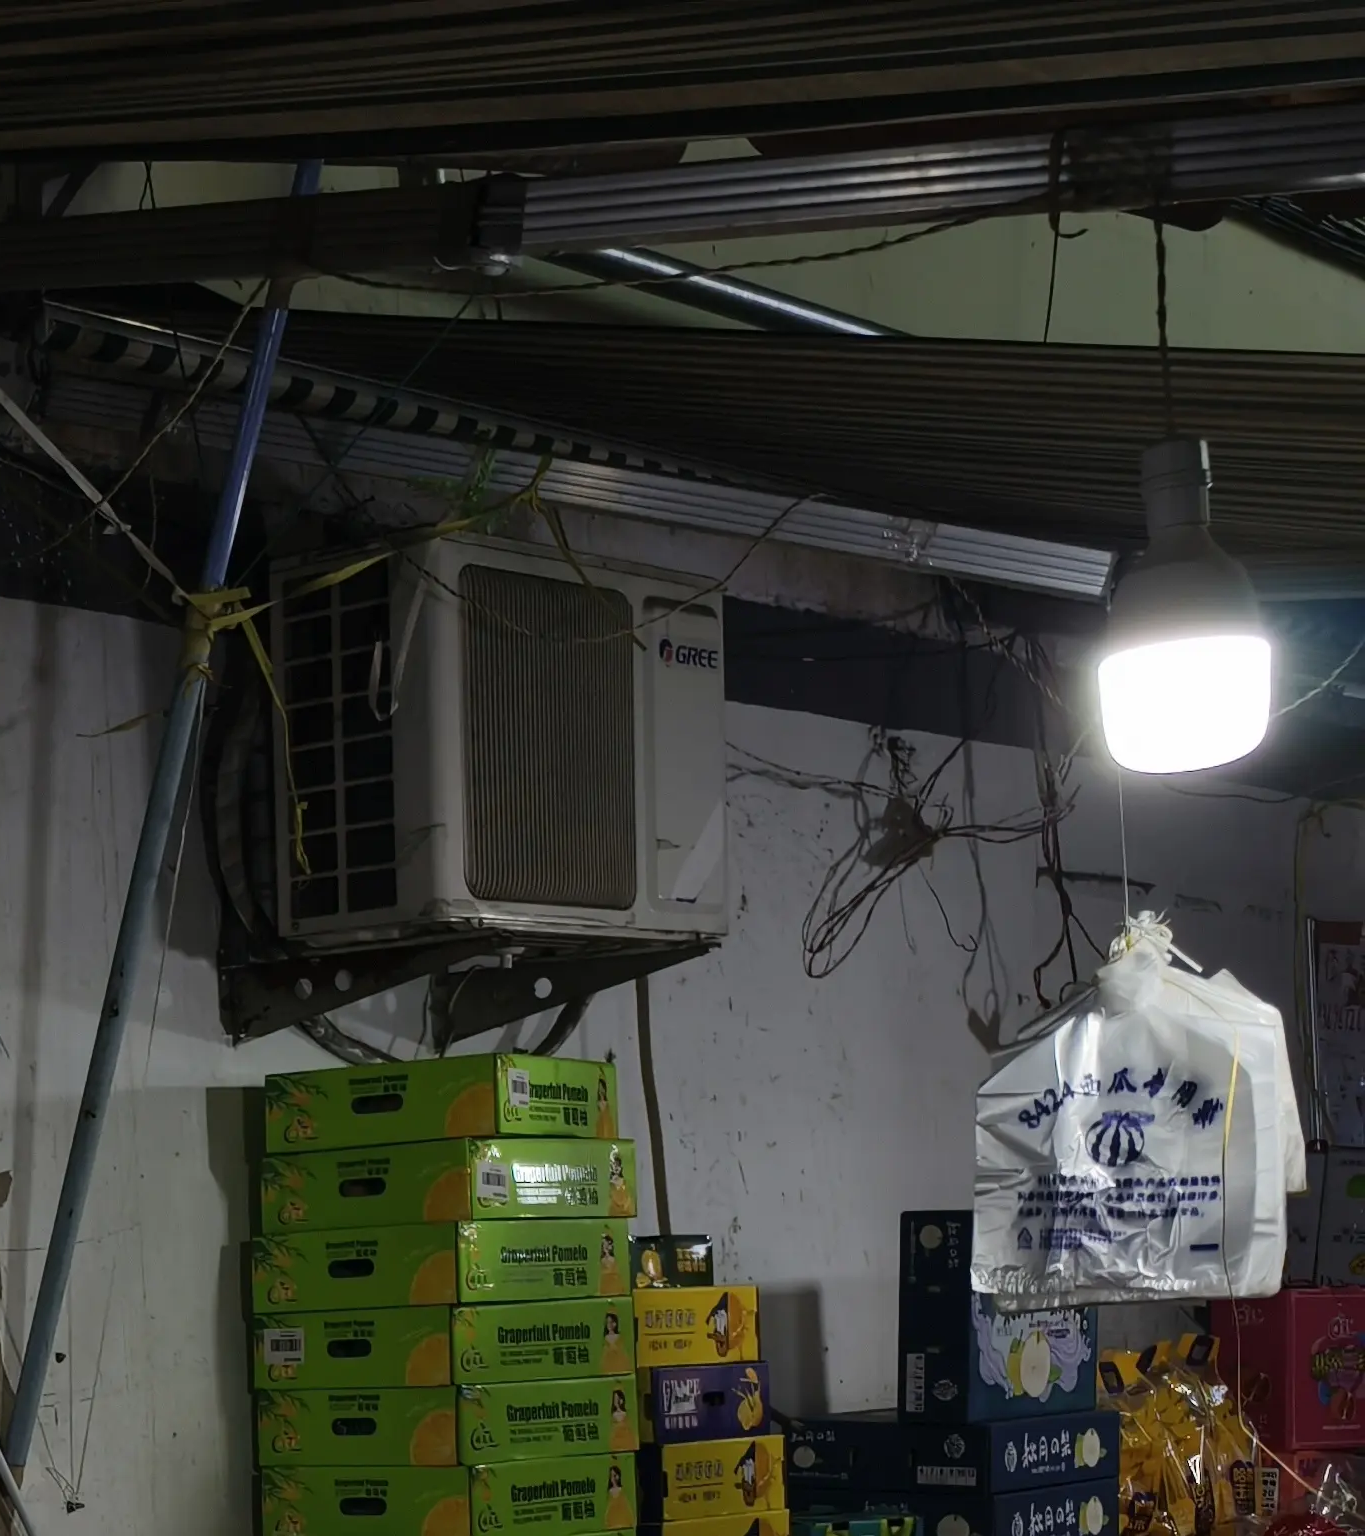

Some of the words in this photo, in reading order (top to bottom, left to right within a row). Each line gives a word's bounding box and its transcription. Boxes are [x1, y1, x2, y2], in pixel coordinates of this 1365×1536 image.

[675, 645, 718, 669] GREE
[552, 1244, 588, 1262] Pomelo
[552, 1322, 590, 1342] Pomelo
[561, 1399, 599, 1419] Pomelo
[561, 1477, 595, 1496] Pomelo
